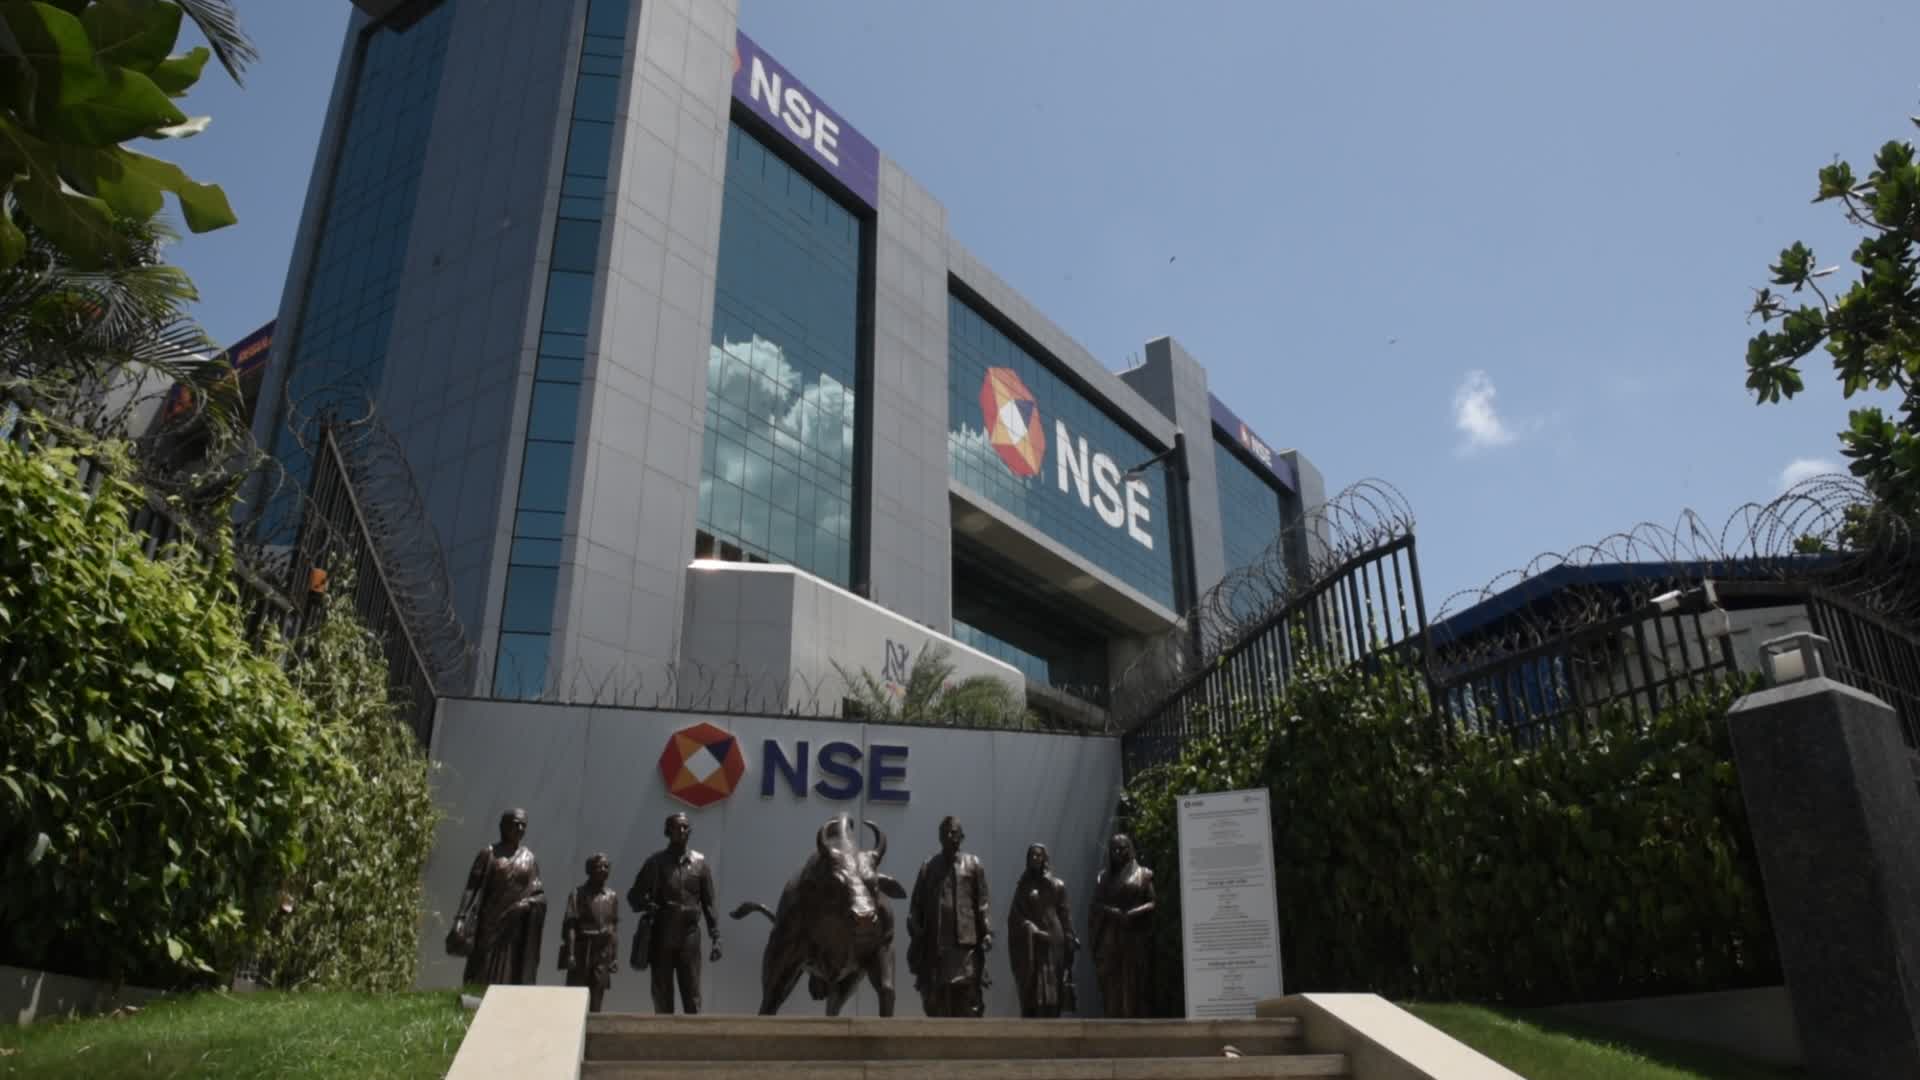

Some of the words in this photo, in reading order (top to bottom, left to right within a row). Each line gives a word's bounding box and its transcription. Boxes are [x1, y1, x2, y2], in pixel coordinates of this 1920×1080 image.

[751, 56, 840, 167] NSE
[1056, 418, 1153, 550] NSE
[761, 739, 911, 802] NSE
